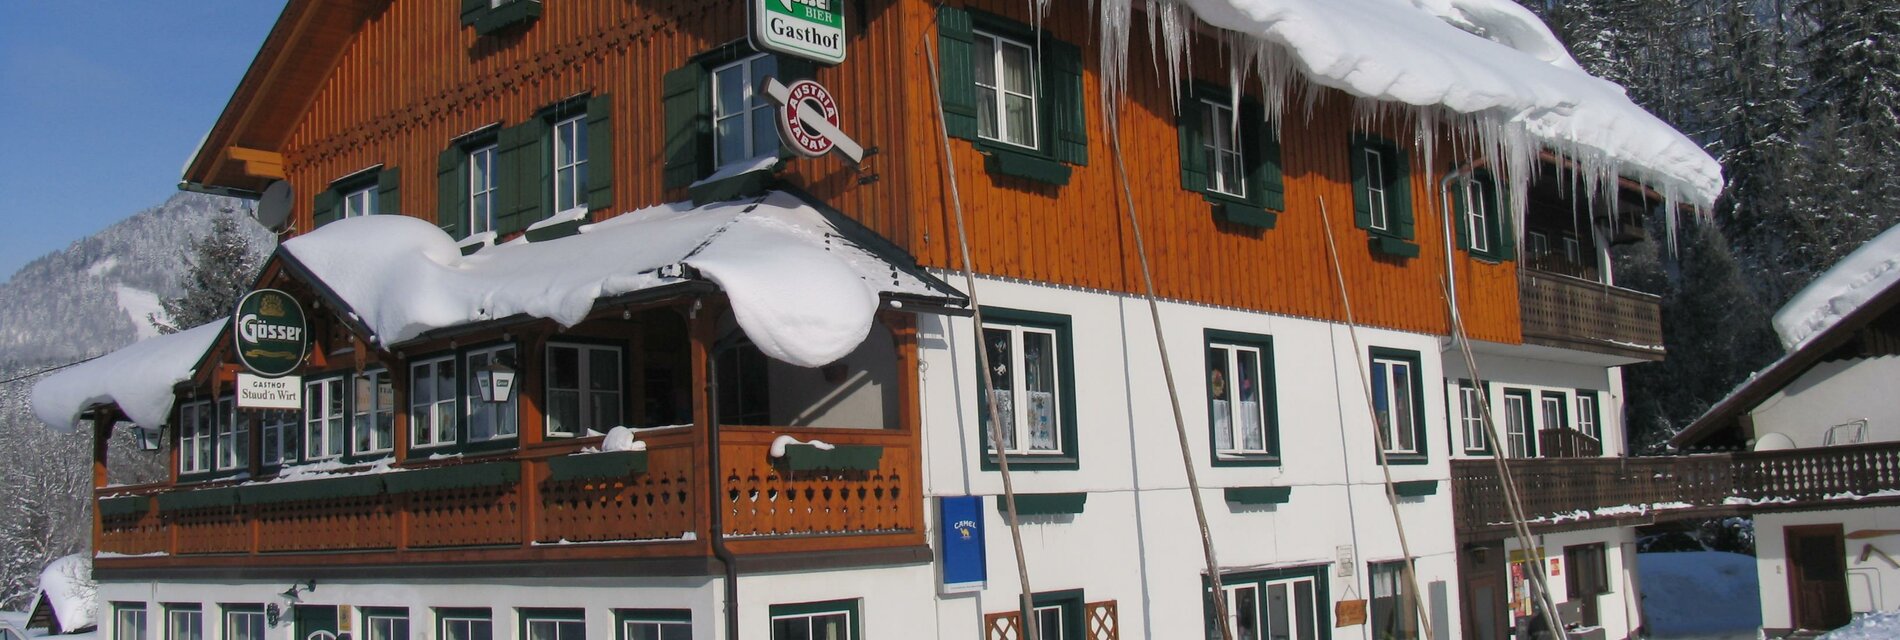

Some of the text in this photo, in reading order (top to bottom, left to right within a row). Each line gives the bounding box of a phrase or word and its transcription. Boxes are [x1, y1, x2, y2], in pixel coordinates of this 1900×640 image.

[805, 6, 833, 23] BIER
[770, 17, 839, 50] Gasthof
[789, 84, 835, 118] AUSTRIA
[789, 116, 827, 150] TABAK
[240, 313, 302, 344] Gösser
[253, 381, 286, 389] GASTHOF
[277, 390, 296, 401] Wirt
[954, 520, 977, 529] CAMEL
